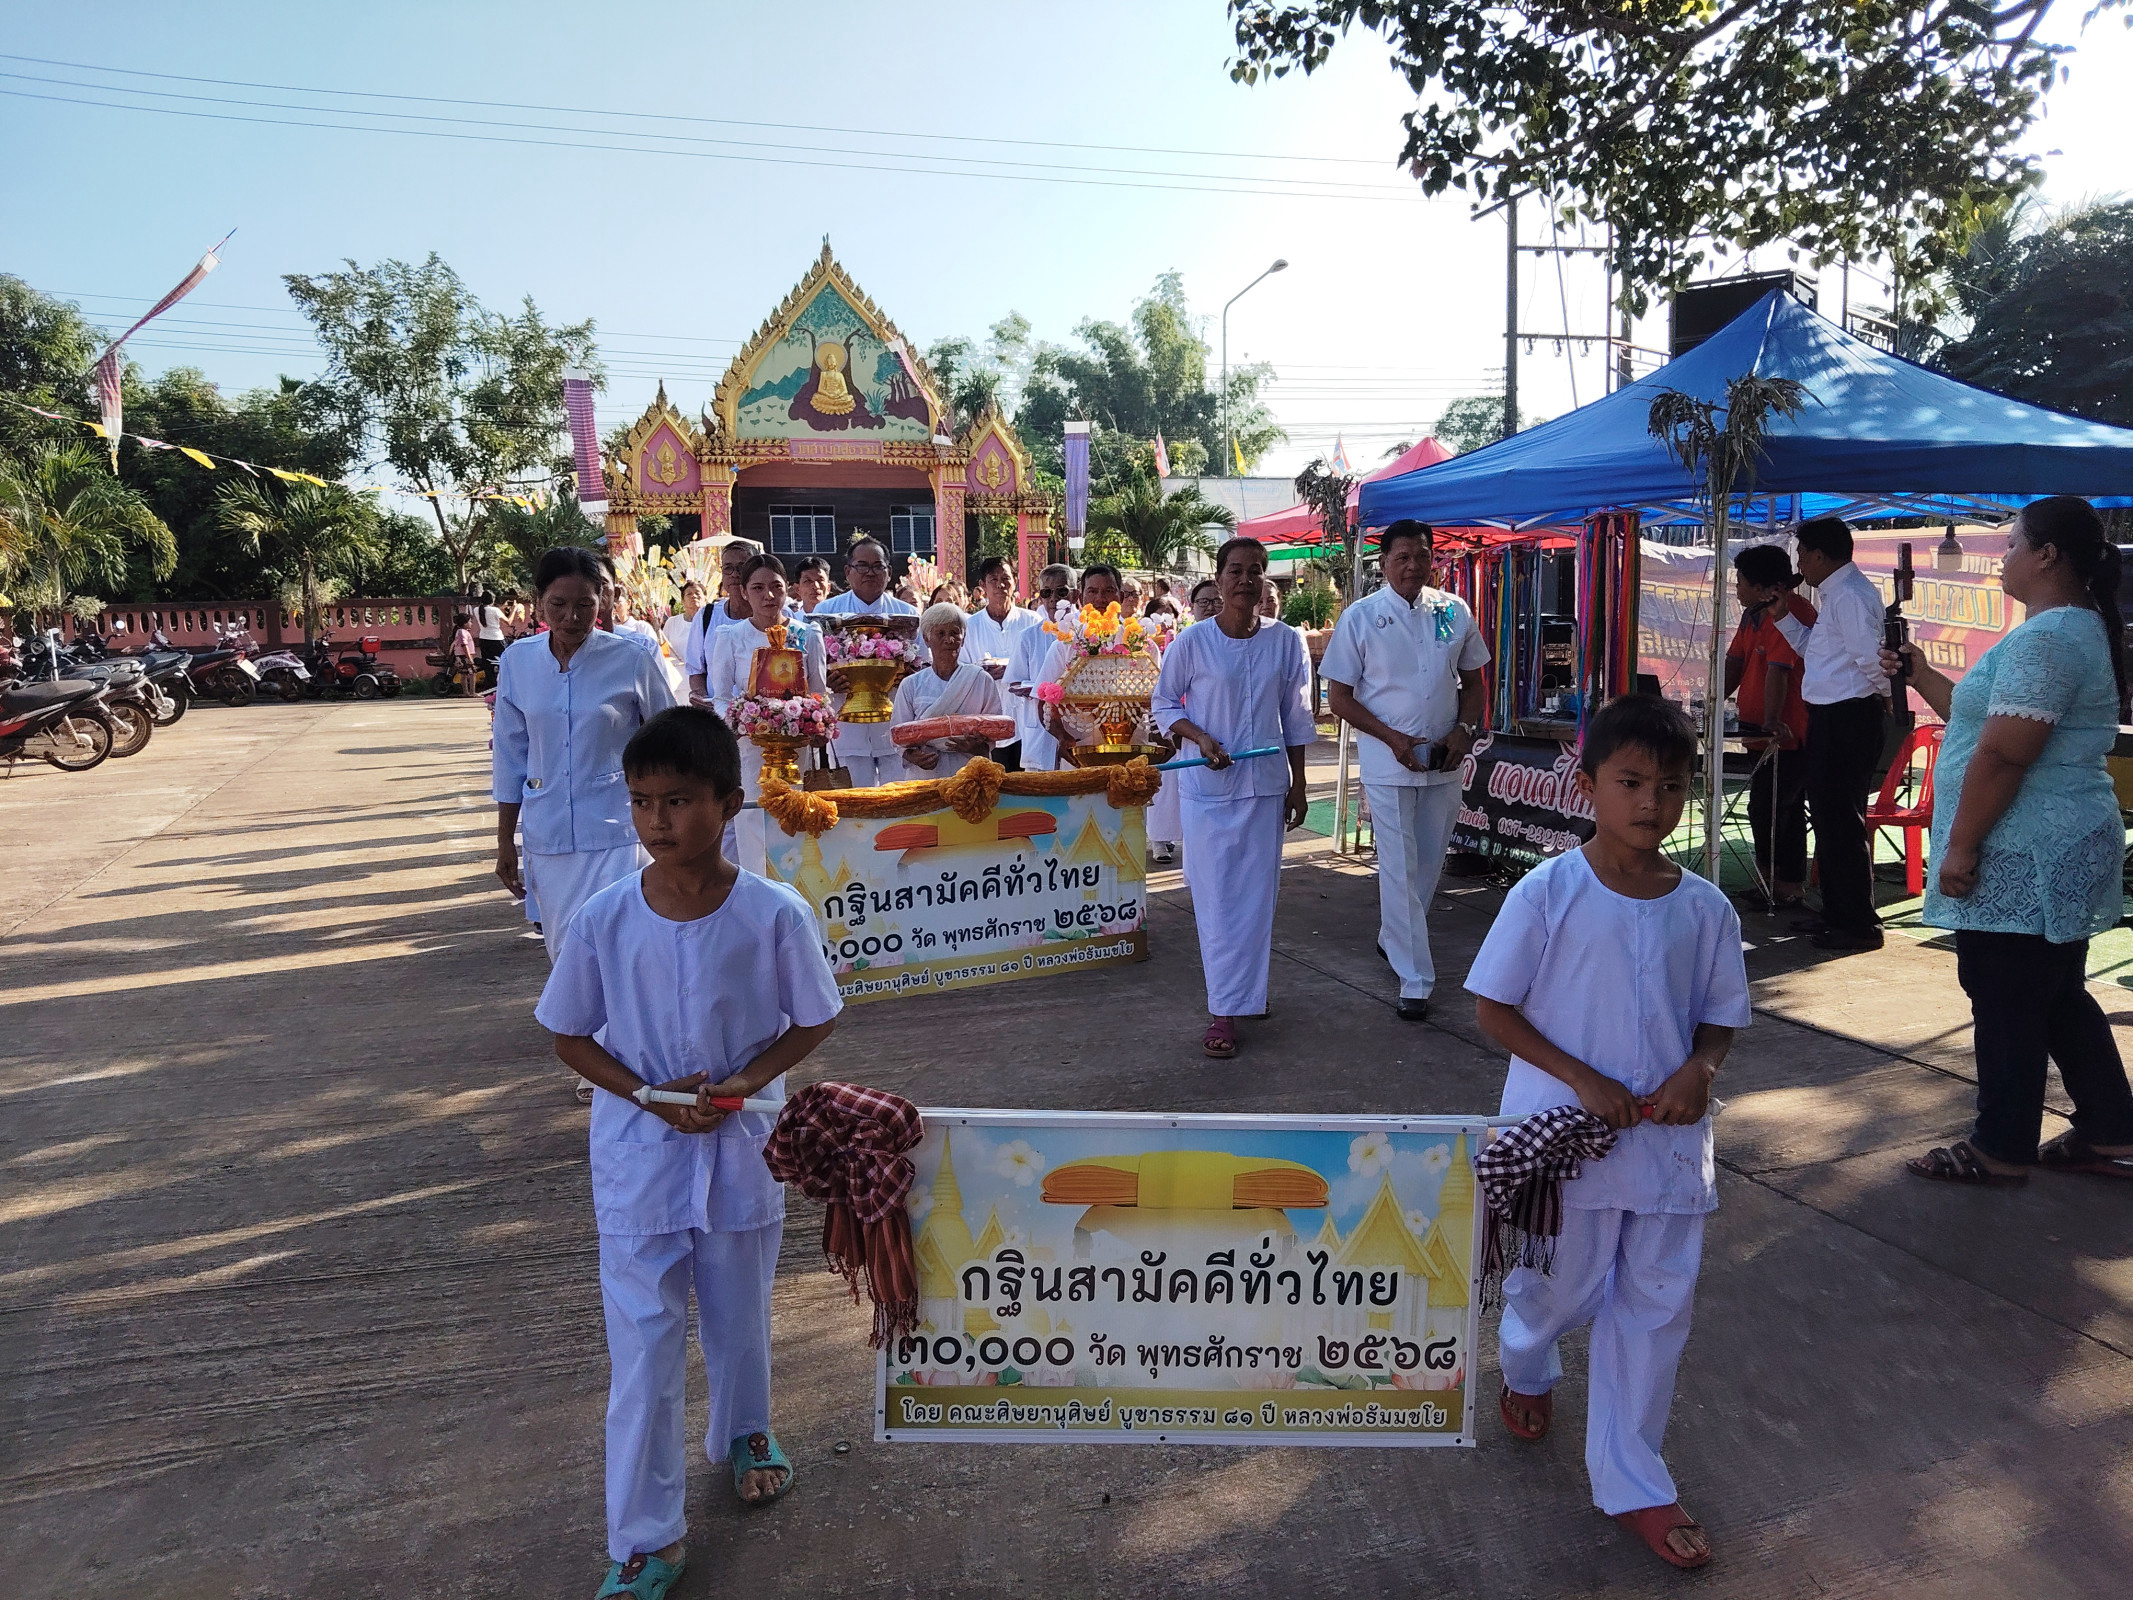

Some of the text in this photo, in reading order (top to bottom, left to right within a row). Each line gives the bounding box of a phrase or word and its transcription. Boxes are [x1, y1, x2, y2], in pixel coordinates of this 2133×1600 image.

[824, 853, 1100, 926] กฐินสามัคคีทั่วไทย
[911, 927, 936, 948] วัด
[942, 914, 1046, 952] พุทธศักราช
[1053, 898, 1138, 929] ๒๕๖๘
[934, 964, 996, 988] บูชาธรรม
[1000, 960, 1019, 975] ๘๑
[1024, 953, 1034, 970] ปี
[1037, 942, 1134, 968] หลวงพ่อธัมมชโย
[962, 1236, 1398, 1318] กฐินสามัคคีทั่วไทย
[897, 1332, 1457, 1379] ๓๐,๐๐๐ วัด พุทธศักราช ๒๕๖๘
[902, 1399, 1447, 1430] โดย คณะศิษยานุศิษย์ บูชาธรรม ๘๑ ปี หลวงพ่อธัมมชโย
